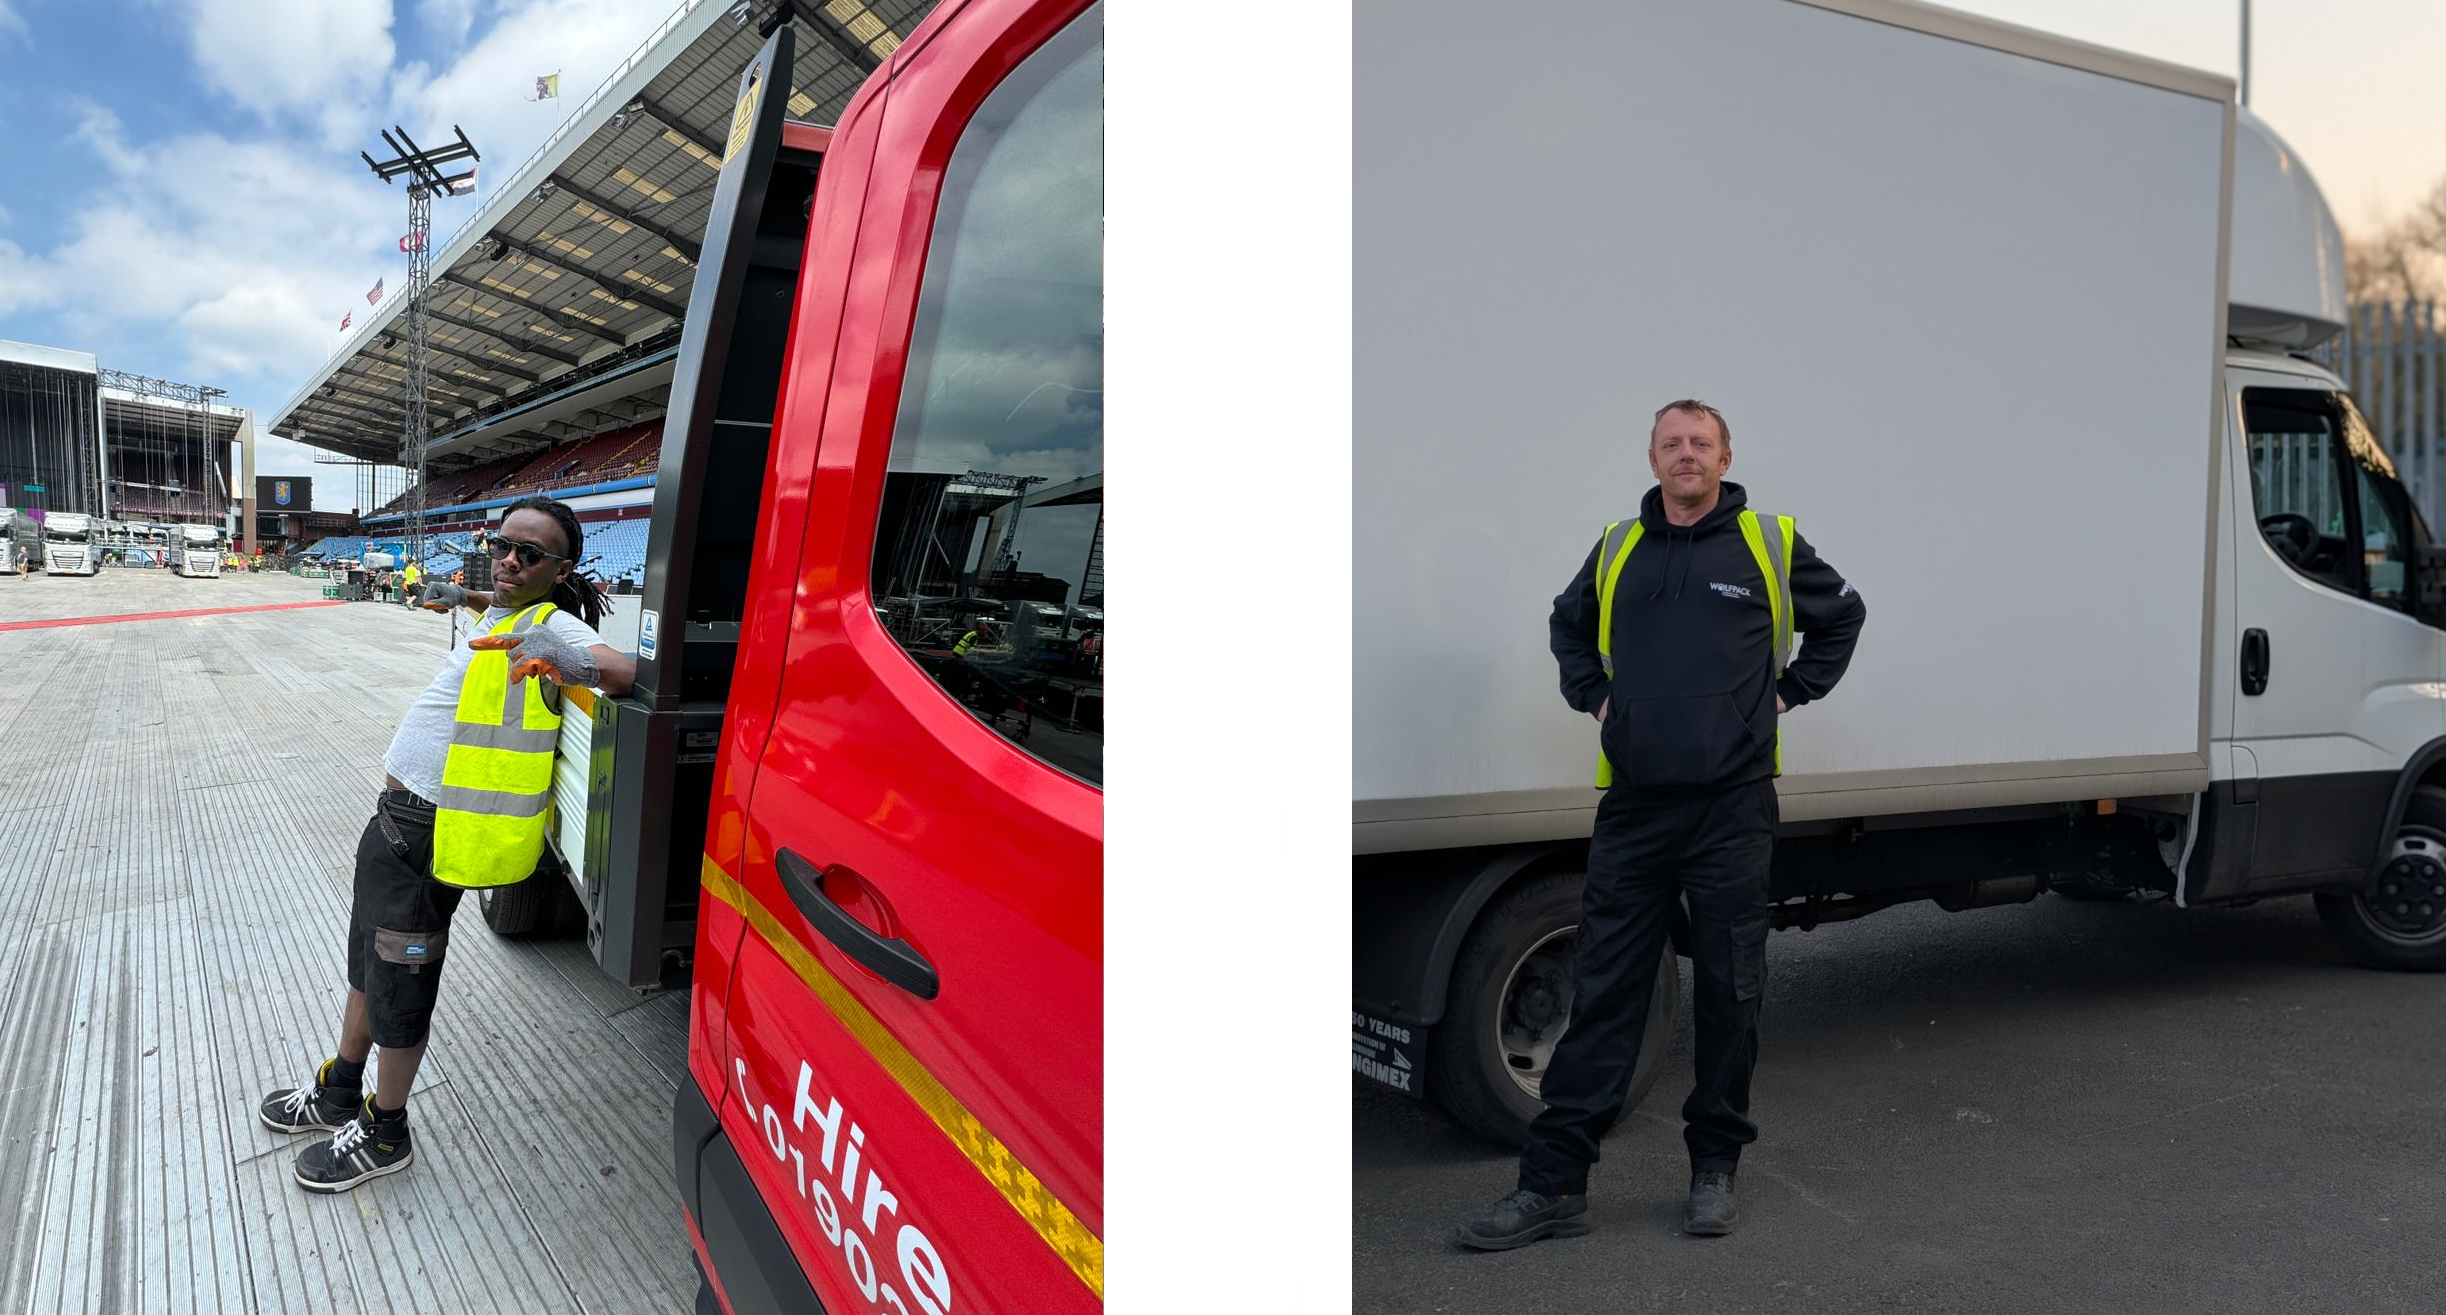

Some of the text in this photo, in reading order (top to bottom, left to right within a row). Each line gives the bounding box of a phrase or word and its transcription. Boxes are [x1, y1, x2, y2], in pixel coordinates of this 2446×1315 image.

[1709, 581, 1751, 597] WOLFPACK
[1368, 1017, 1411, 1044] YEARS
[792, 1059, 952, 1315] Hire
